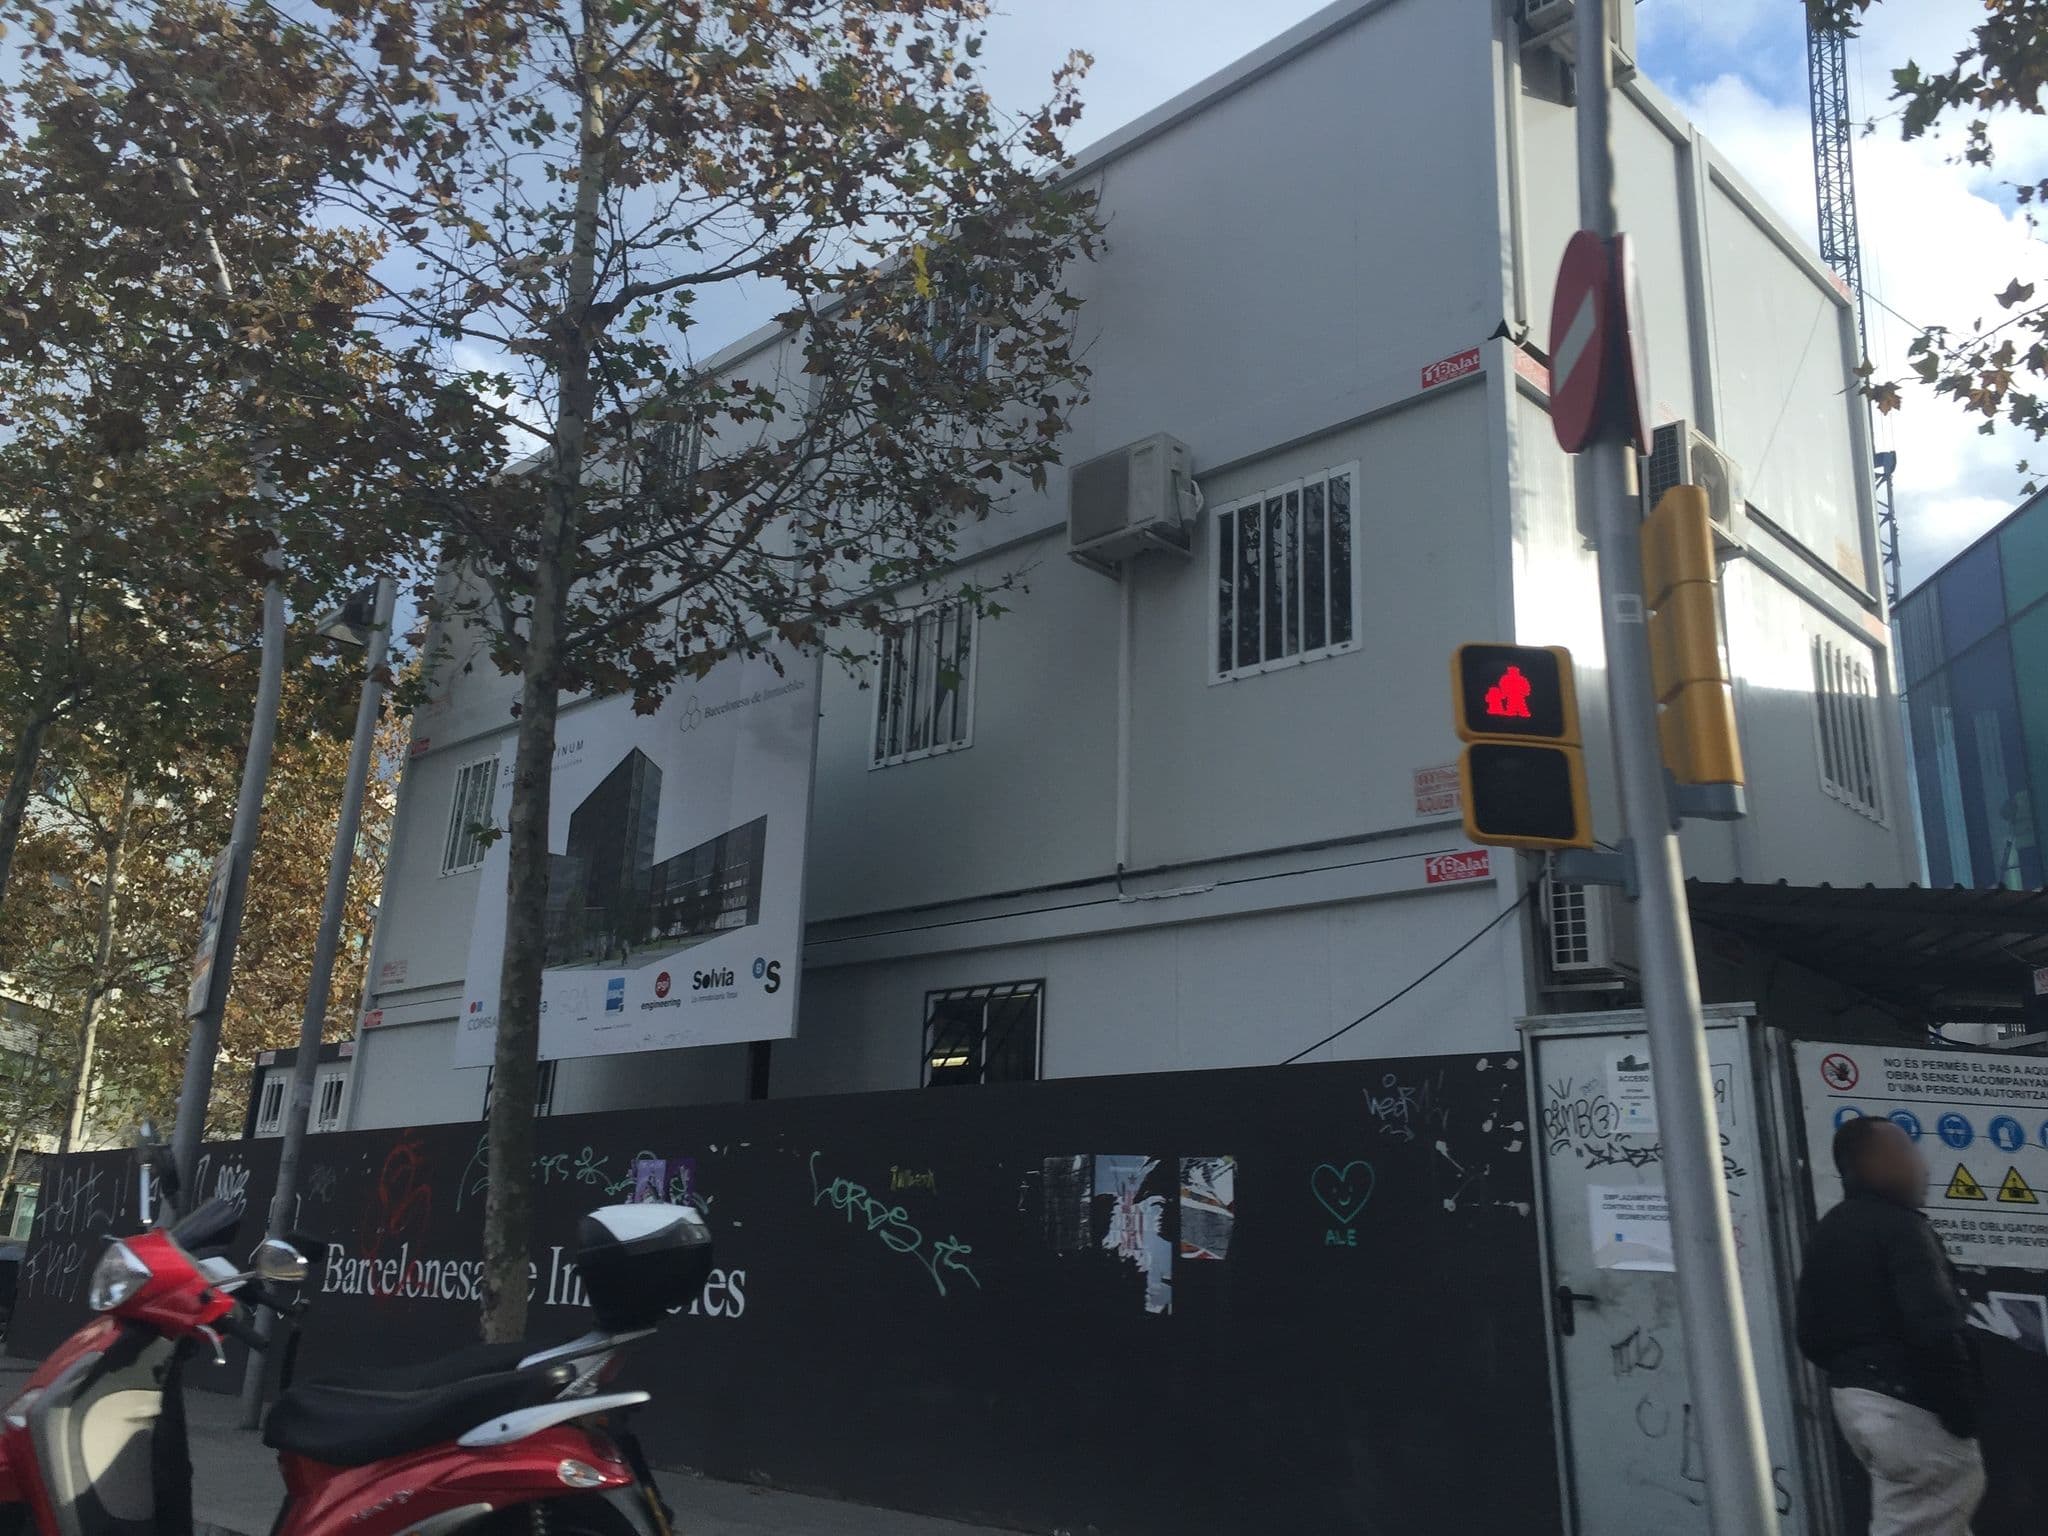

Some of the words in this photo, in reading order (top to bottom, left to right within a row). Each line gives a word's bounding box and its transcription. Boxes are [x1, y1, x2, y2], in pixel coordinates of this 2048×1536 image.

[692, 967, 735, 990] Solvia
[641, 999, 681, 1011] engineering
[1883, 1058, 1901, 1068] NO
[1971, 1063, 1986, 1073] EL
[1989, 1064, 2011, 1074] PAS
[1886, 1071, 1919, 1081] OBRA
[1921, 1072, 1959, 1084] SENSE
[1888, 1083, 1923, 1093] D'UNA
[1926, 1084, 1982, 1097] PERSONA
[1932, 1219, 1959, 1230] BRA
[1325, 1229, 1357, 1246] ALE
[1943, 1233, 1986, 1244] ORMES
[1989, 1235, 2005, 1246] DE
[320, 1242, 484, 1301] Barcelonesa
